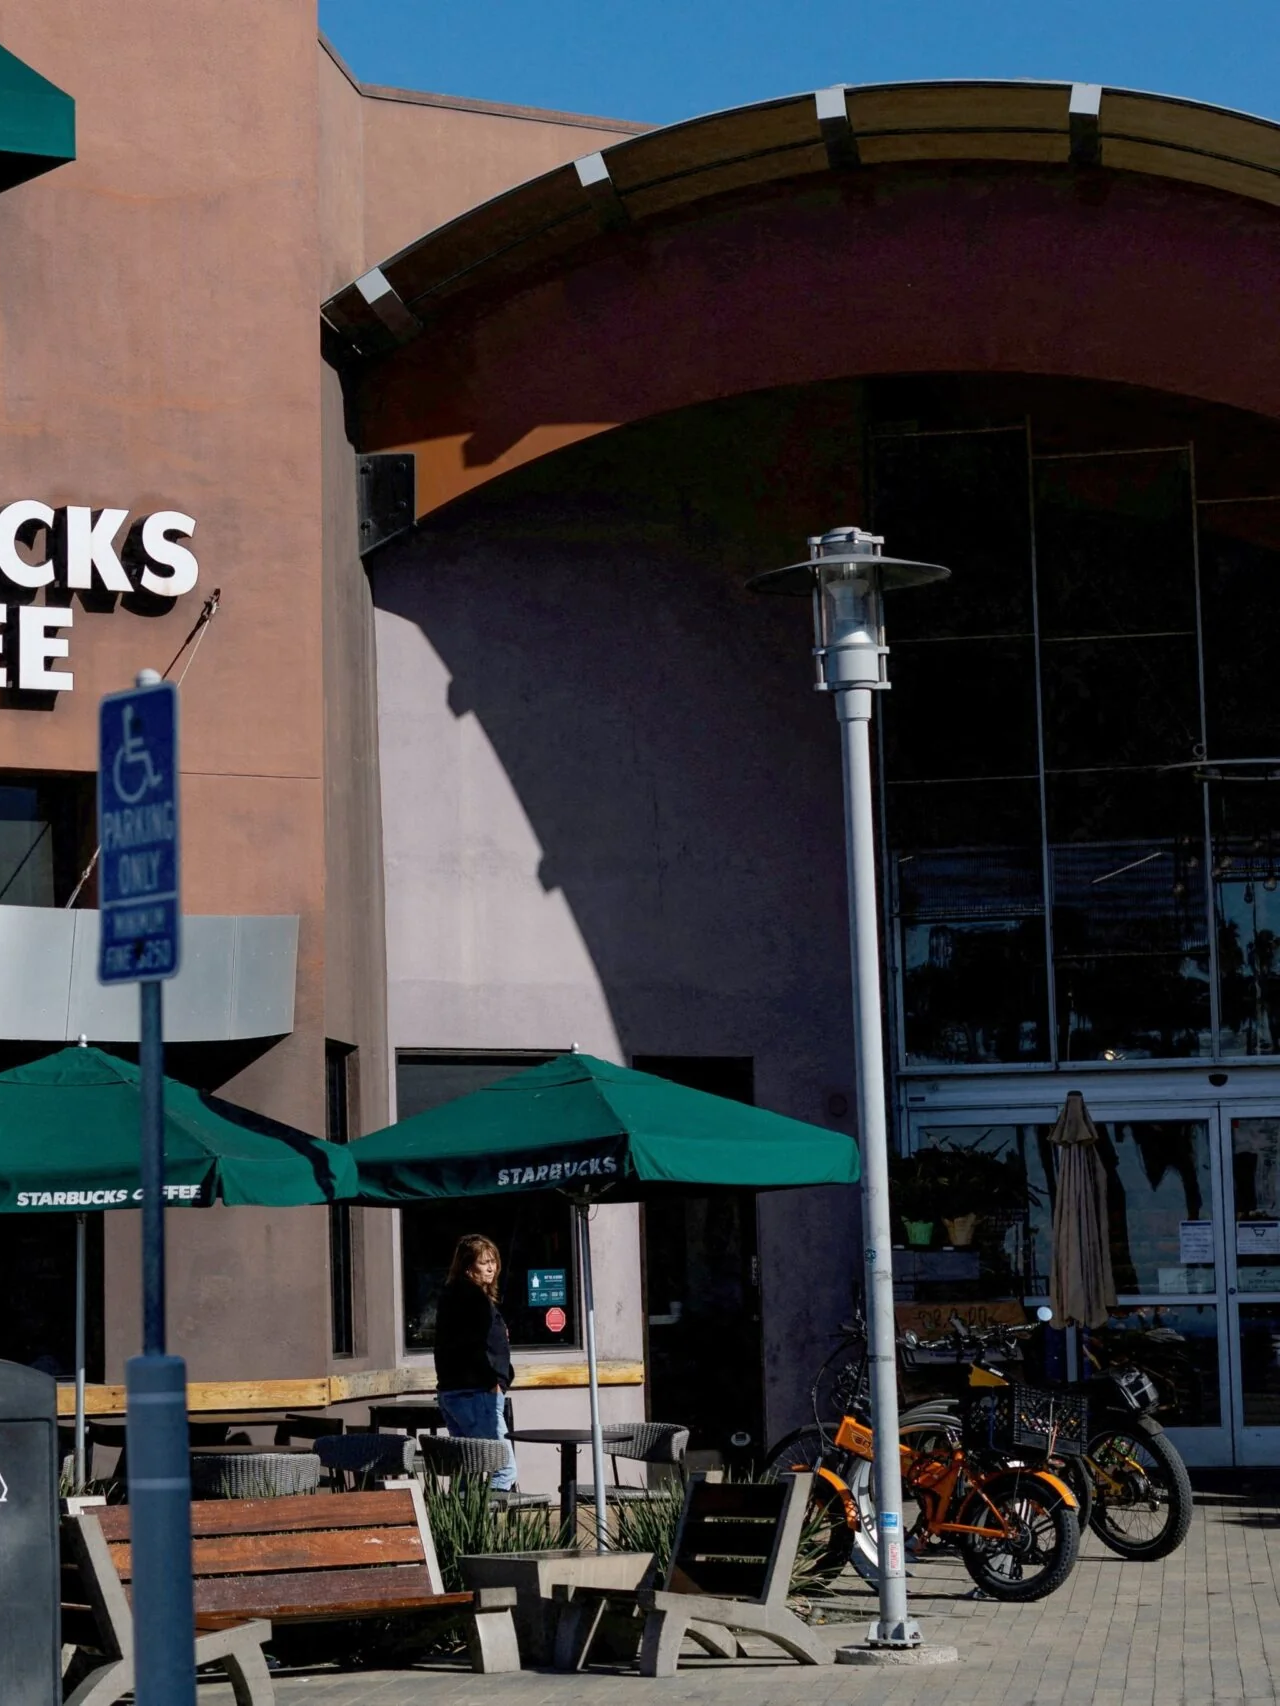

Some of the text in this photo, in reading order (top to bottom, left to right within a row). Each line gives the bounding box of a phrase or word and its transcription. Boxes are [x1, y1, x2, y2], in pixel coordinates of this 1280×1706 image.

[103, 803, 174, 852] PARKING
[119, 850, 160, 895] ONLY
[497, 1156, 617, 1186] STARBUCKS
[16, 1189, 128, 1207] STARBUCKS
